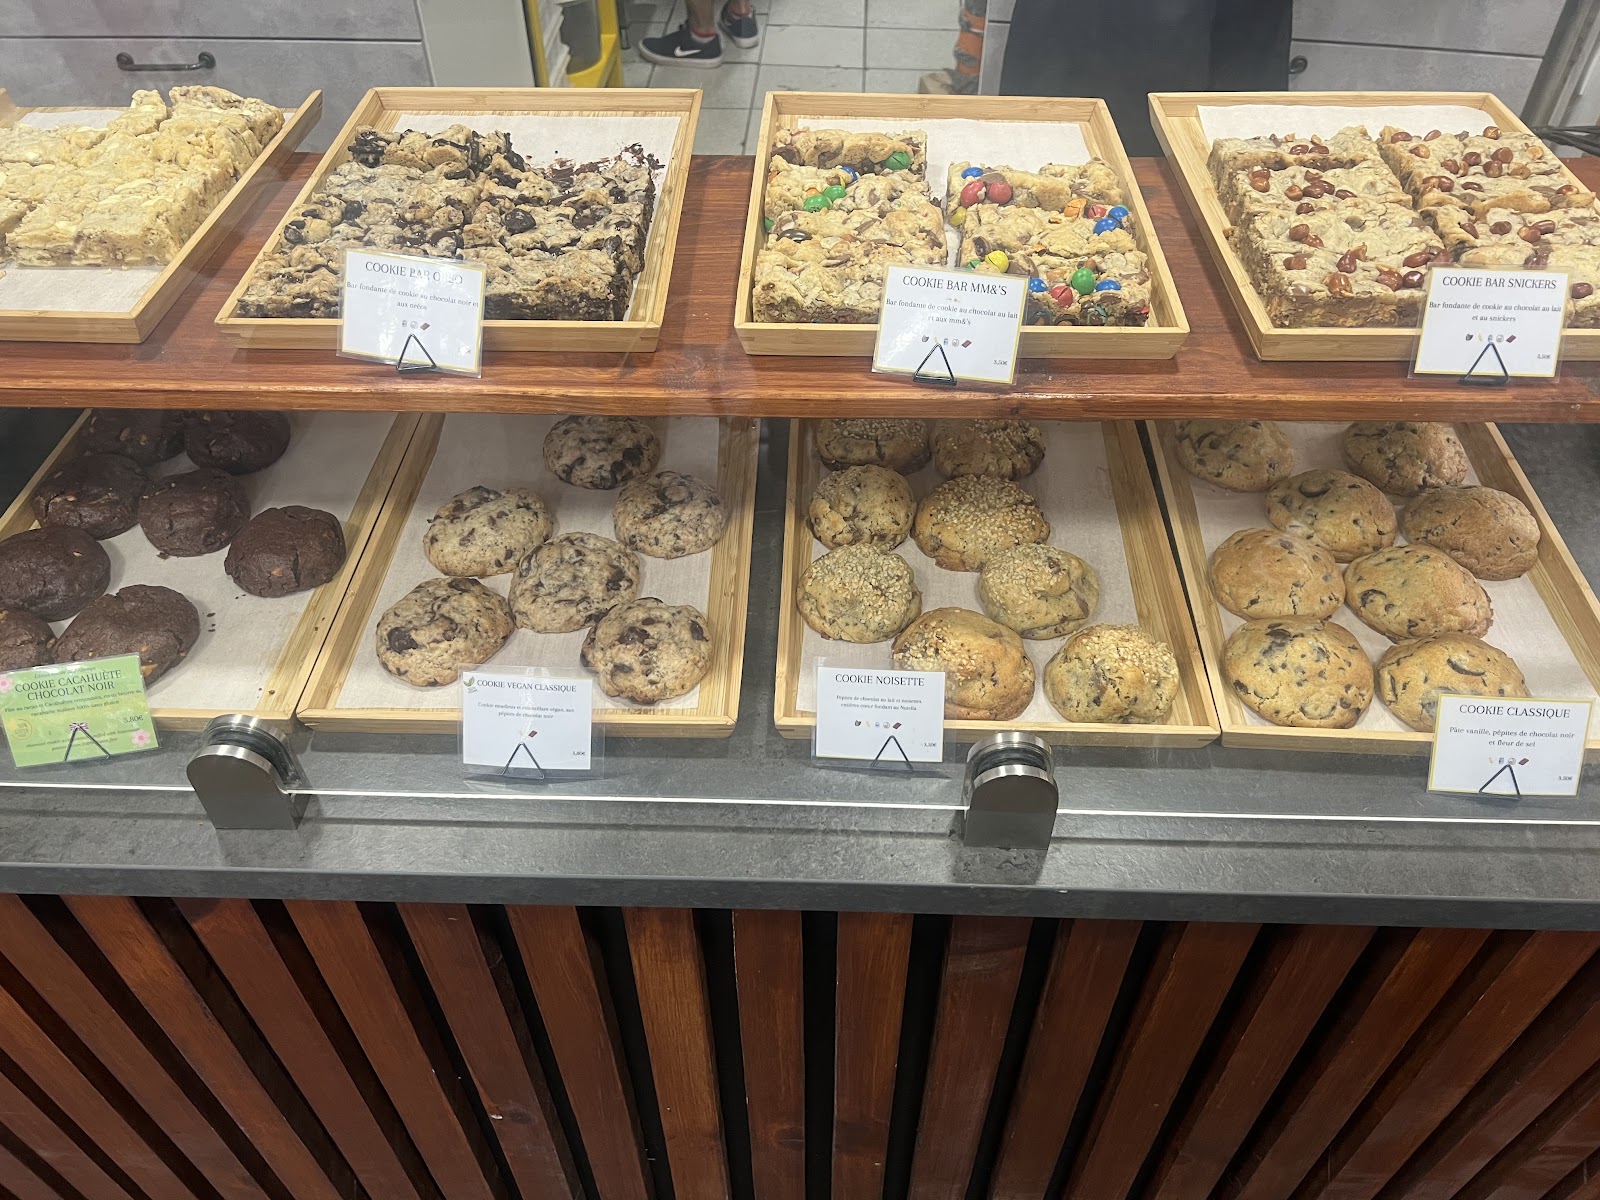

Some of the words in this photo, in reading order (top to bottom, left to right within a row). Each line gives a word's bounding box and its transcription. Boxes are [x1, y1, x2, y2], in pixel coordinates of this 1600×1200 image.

[366, 261, 406, 276] COOKIE
[409, 268, 430, 280] BAR
[902, 275, 944, 289] COOKIE
[946, 280, 968, 292] BAR
[970, 282, 1007, 296] MM&'S
[1442, 276, 1482, 287] COOKIE
[1485, 278, 1505, 288] BAR
[1508, 278, 1556, 289] SNICKERS
[360, 283, 387, 293] fondante
[398, 290, 418, 298] cookie
[430, 295, 455, 304] chocolat
[898, 300, 927, 309] fondante
[937, 304, 958, 312] cookie
[968, 308, 996, 317] chocolat
[949, 317, 971, 325] mm&'s
[15, 679, 55, 693] COOKIE
[58, 670, 122, 686] CACAHUÈTE
[477, 680, 505, 688] COOKIE
[507, 682, 533, 690] VEGAN
[535, 683, 576, 693] CLASSIQUE
[836, 674, 873, 684] COOKIE
[876, 676, 924, 686] NOISETTE
[27, 686, 84, 701] CHOCOLAT
[88, 681, 115, 692] NOIR
[1460, 704, 1503, 715] COOKIE
[1507, 707, 1570, 719] CLASSIQUE
[1492, 729, 1517, 737] pépites
